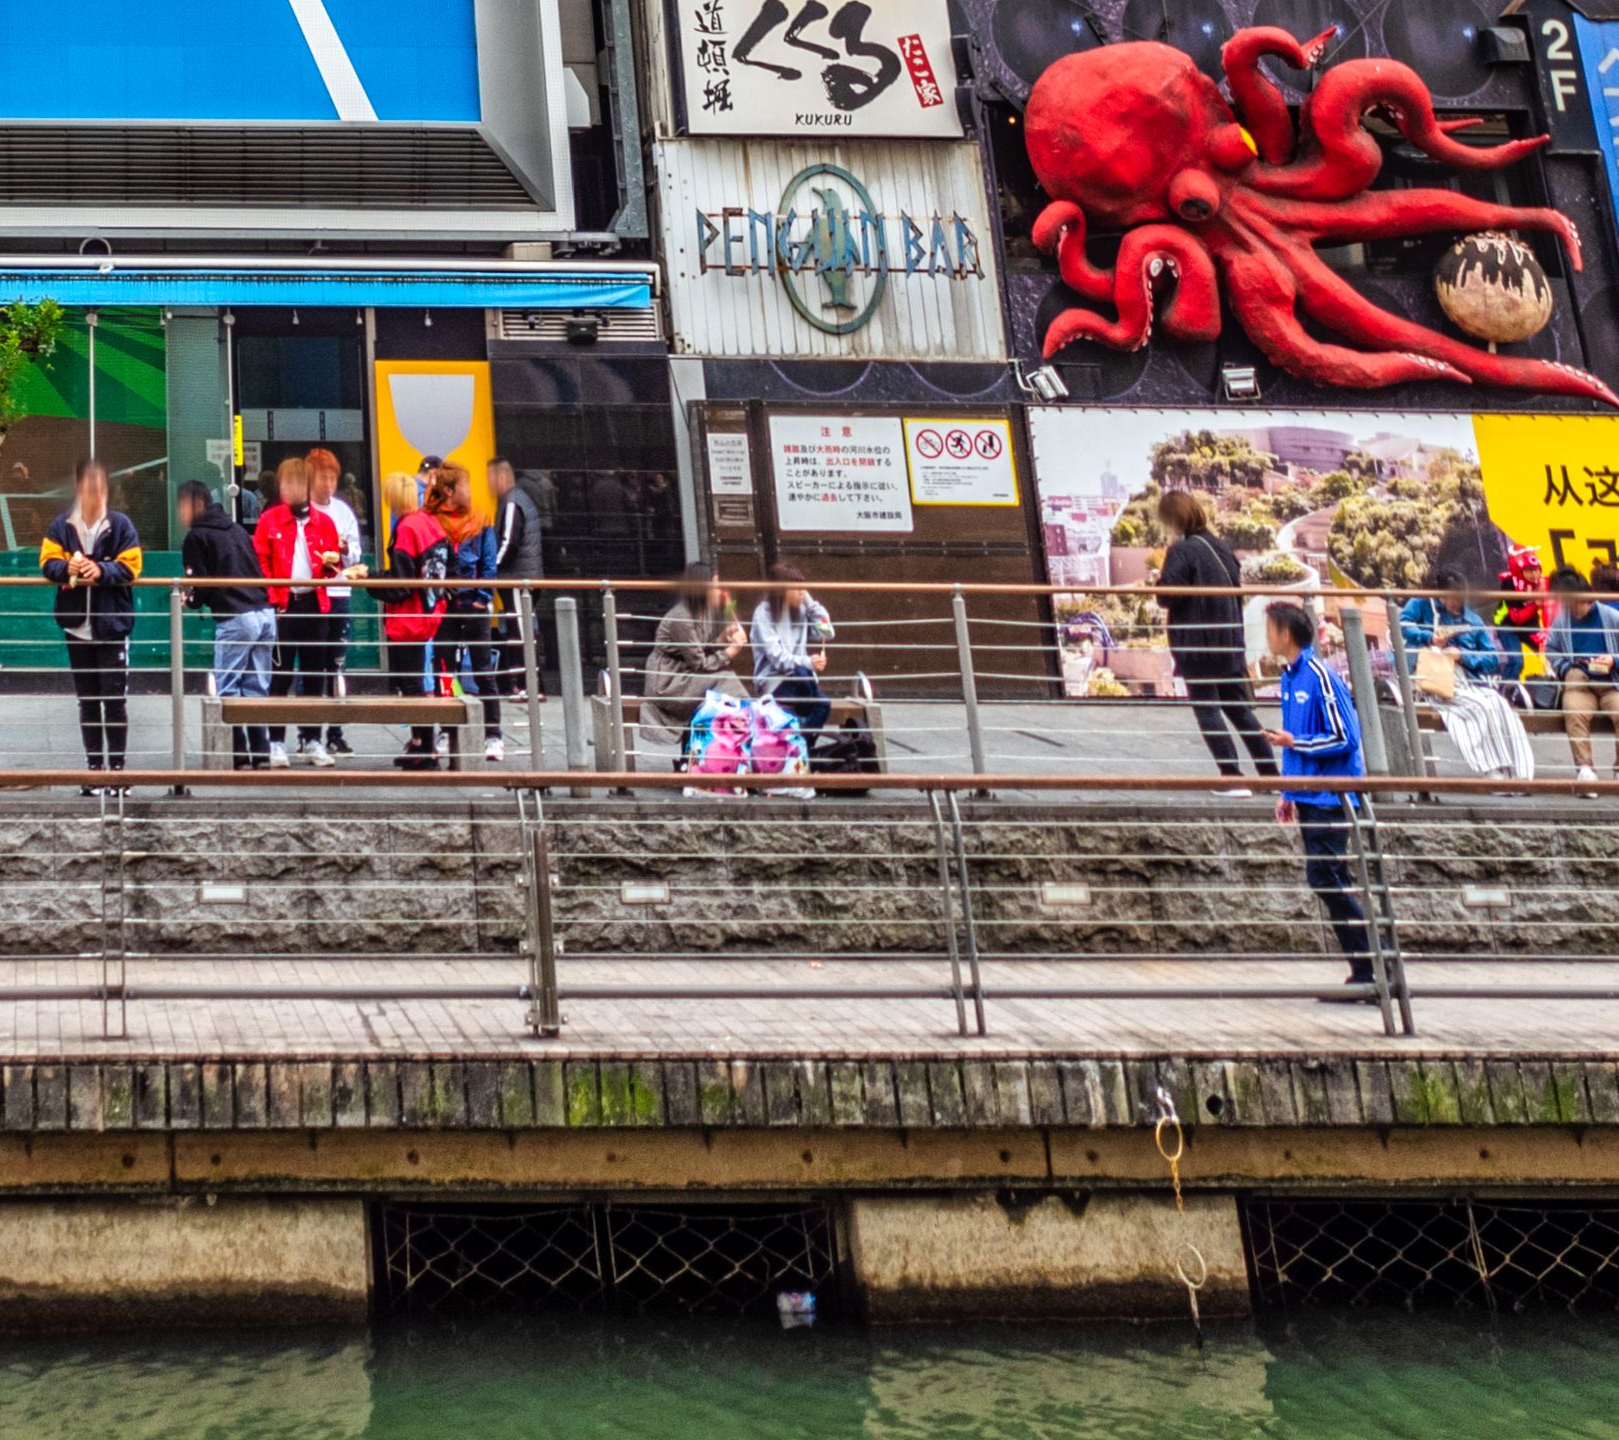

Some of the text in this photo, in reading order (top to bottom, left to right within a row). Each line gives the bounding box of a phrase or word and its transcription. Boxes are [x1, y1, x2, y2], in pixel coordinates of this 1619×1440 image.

[1541, 19, 1577, 112] 2F
[795, 113, 853, 126] KUKURU
[695, 206, 986, 282] PENGUIN BAR
[821, 426, 852, 438] 注意
